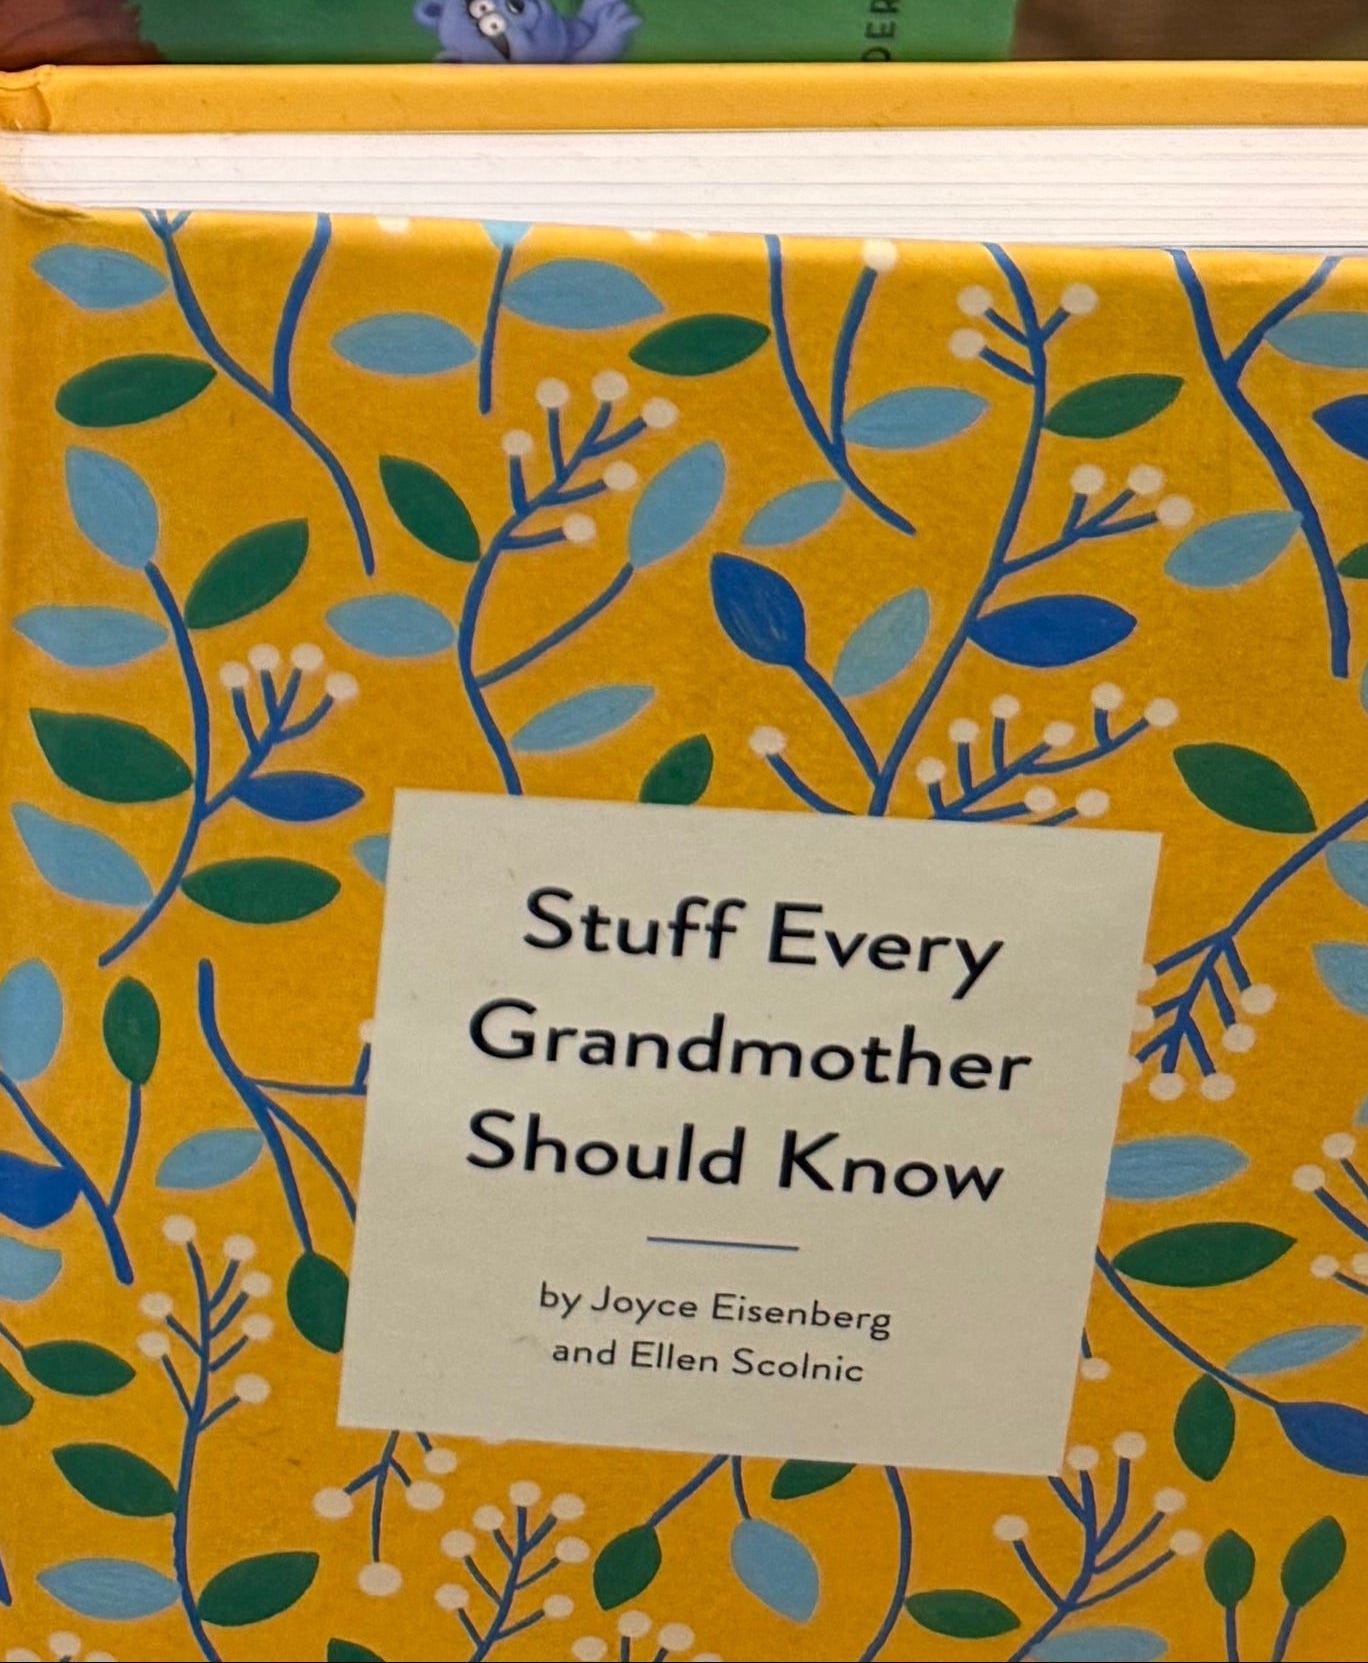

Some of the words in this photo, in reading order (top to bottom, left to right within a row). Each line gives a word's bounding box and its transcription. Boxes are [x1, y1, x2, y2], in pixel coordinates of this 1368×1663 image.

[522, 885, 749, 961] Stuff
[767, 900, 1005, 1000] Every
[467, 996, 1033, 1093] Grandmother
[465, 1108, 747, 1187] Should
[777, 1128, 1005, 1203] Know
[538, 1280, 582, 1319] by
[590, 1285, 699, 1325] Joyce
[711, 1292, 893, 1341] Eisenberg
[551, 1339, 619, 1371] and
[629, 1341, 719, 1374] Ellen
[731, 1347, 864, 1384] Scolnic
